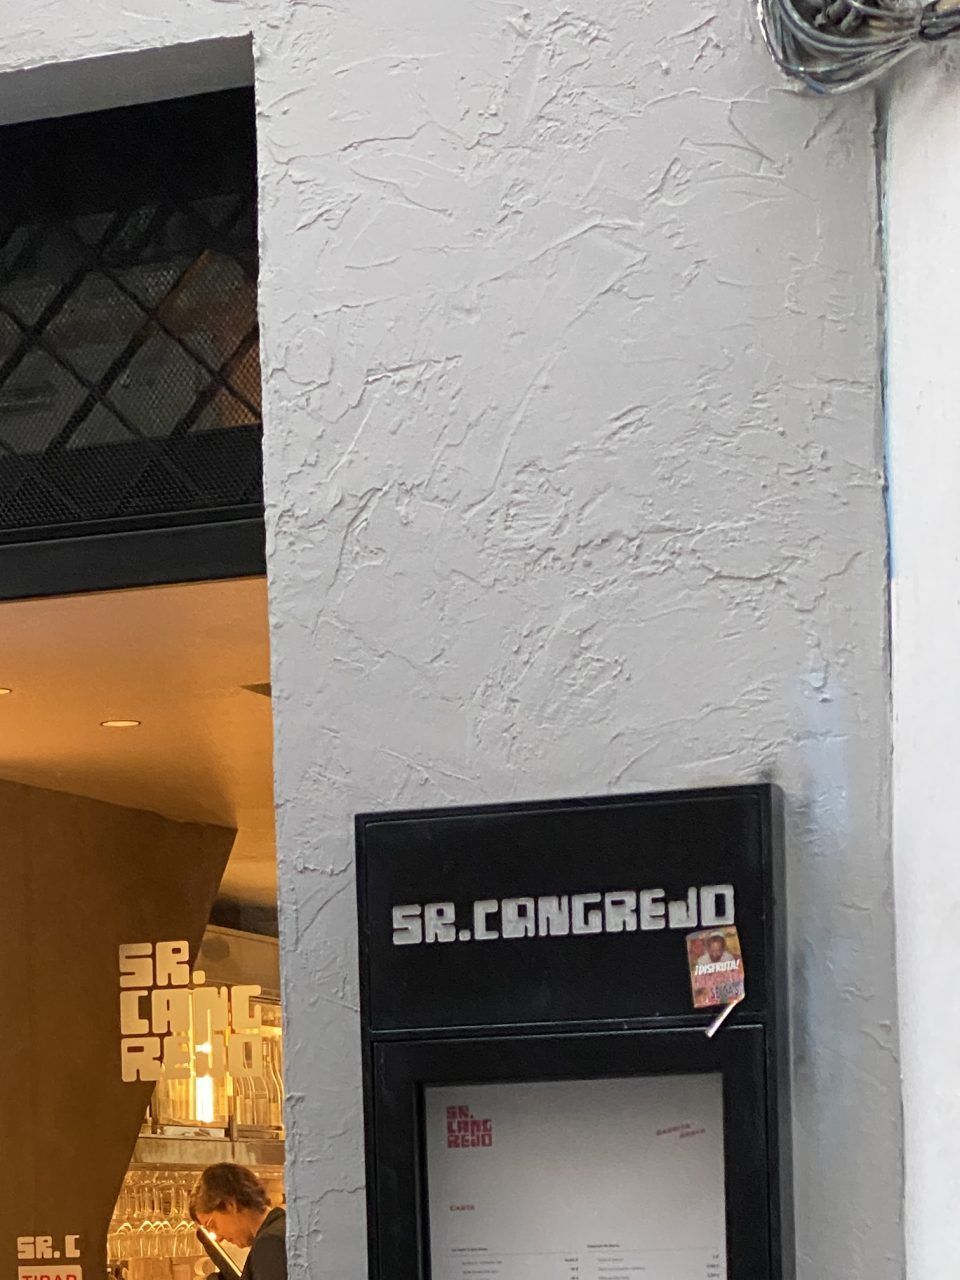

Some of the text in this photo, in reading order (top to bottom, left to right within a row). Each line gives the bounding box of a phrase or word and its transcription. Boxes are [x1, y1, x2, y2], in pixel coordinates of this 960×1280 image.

[392, 884, 735, 945] SR.CANGREJO
[119, 940, 206, 988] SR.
[120, 985, 262, 1037] CANG
[121, 1034, 263, 1082] REJO
[447, 1105, 474, 1119] SR.
[448, 1133, 493, 1148] REJO
